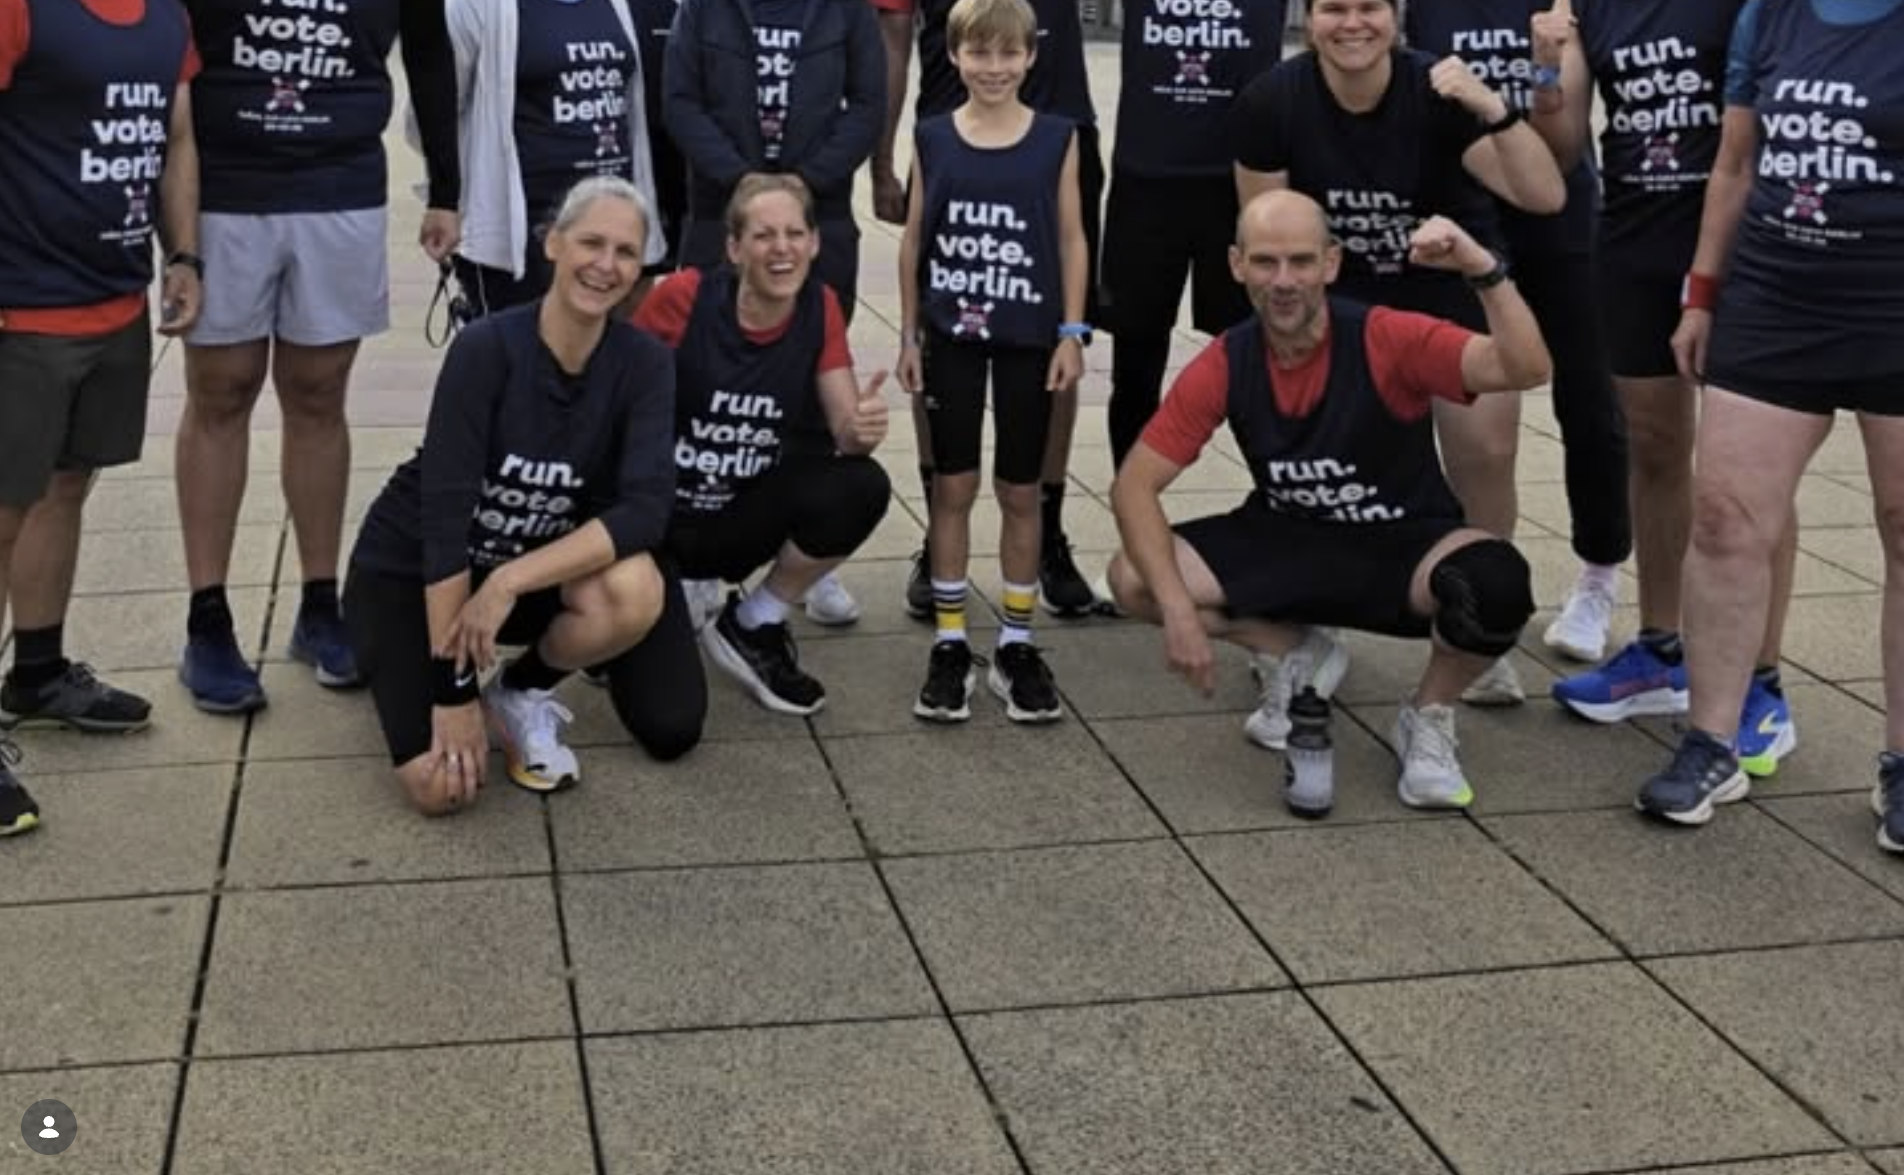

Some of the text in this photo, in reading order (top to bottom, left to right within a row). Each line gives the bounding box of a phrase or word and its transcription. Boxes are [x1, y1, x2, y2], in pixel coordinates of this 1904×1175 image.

[244, 13, 352, 48] vote.
[1143, 16, 1251, 49] berlin.
[1452, 28, 1530, 52] run.
[232, 35, 356, 79] berlin.
[565, 40, 627, 62] run.
[1612, 35, 1697, 72] run.
[105, 82, 167, 109] run.
[1612, 68, 1714, 103] vote.
[1773, 78, 1870, 109] run.
[1612, 96, 1721, 133] berlin
[1760, 110, 1877, 150] vote.
[1757, 142, 1895, 183] berlin.
[949, 199, 1029, 232] run.
[1326, 189, 1413, 209] run.
[936, 232, 1034, 268] vote.
[928, 258, 1044, 304] berlin.
[709, 389, 784, 419] run.
[690, 416, 781, 447] vote.
[499, 452, 585, 488] run.
[1267, 456, 1358, 484] run.
